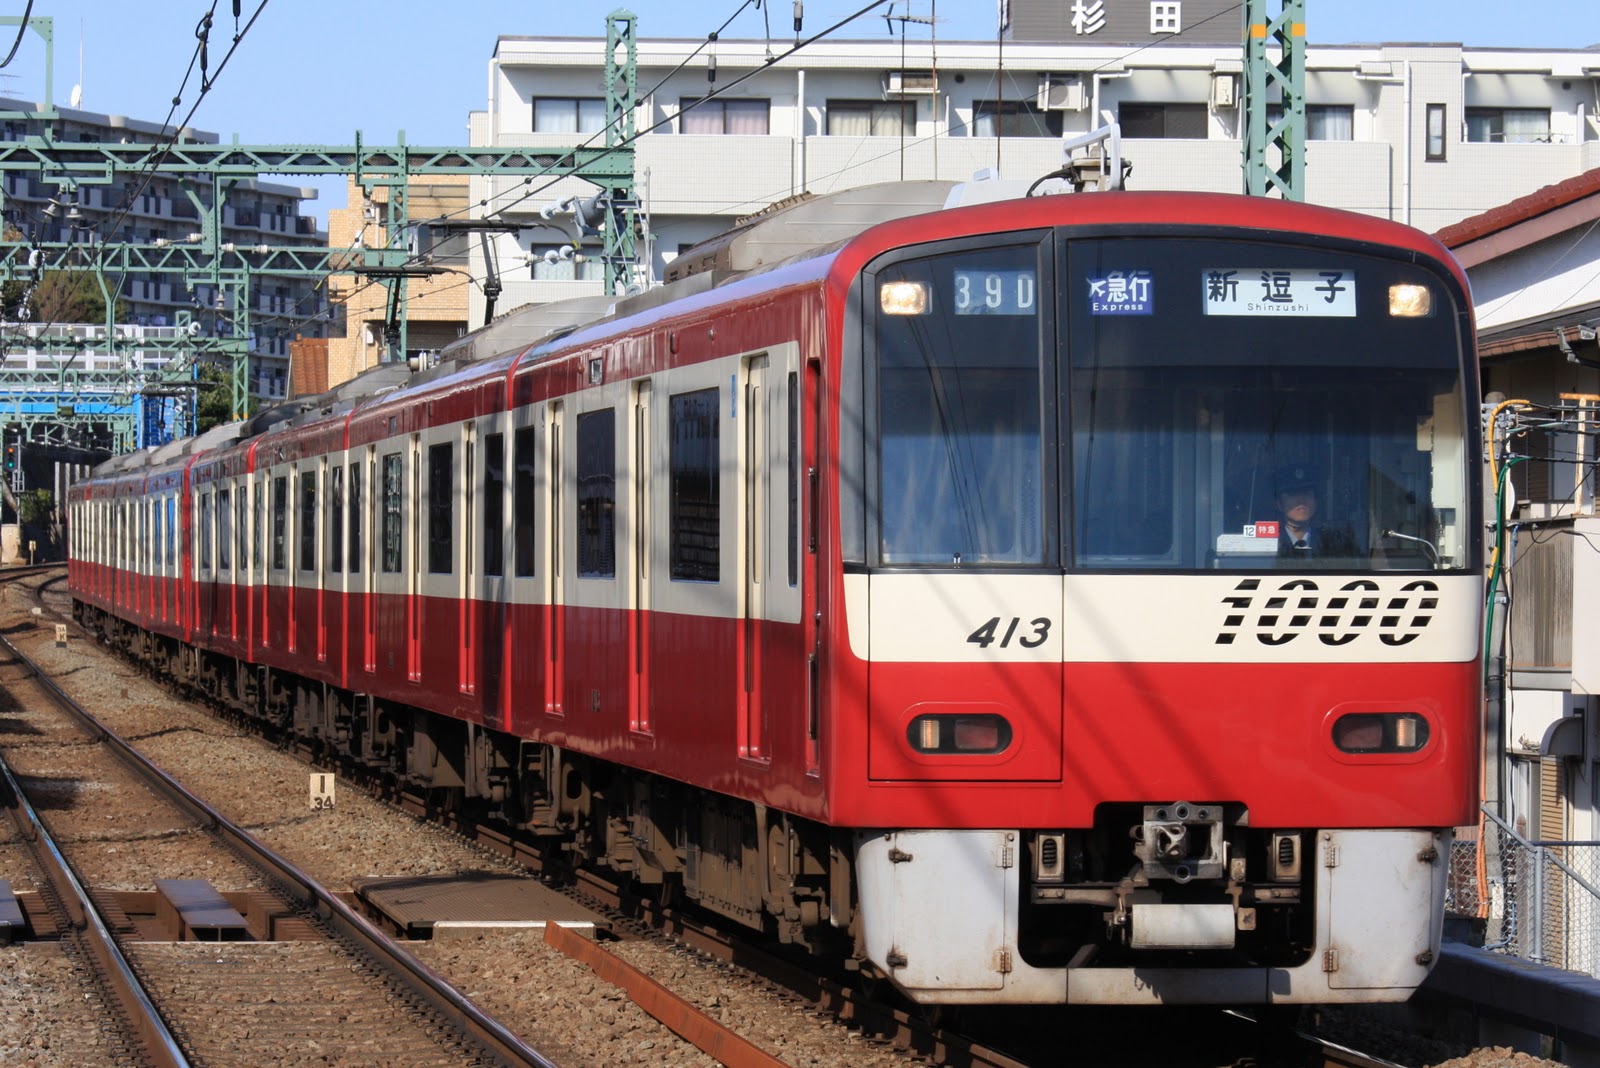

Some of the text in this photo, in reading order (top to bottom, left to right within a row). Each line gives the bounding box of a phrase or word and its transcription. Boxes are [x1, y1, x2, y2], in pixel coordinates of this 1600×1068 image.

[1071, 0, 1181, 35] 杉田
[1106, 270, 1151, 303] 急行
[1208, 270, 1346, 304] 新逗子
[1092, 303, 1144, 312] Express
[1247, 303, 1310, 312] Shinzushi
[1245, 527, 1254, 536] 12
[1258, 525, 1276, 534] 特急
[1214, 578, 1440, 647] 1000
[965, 616, 1053, 649] 413
[313, 796, 334, 811] 34
